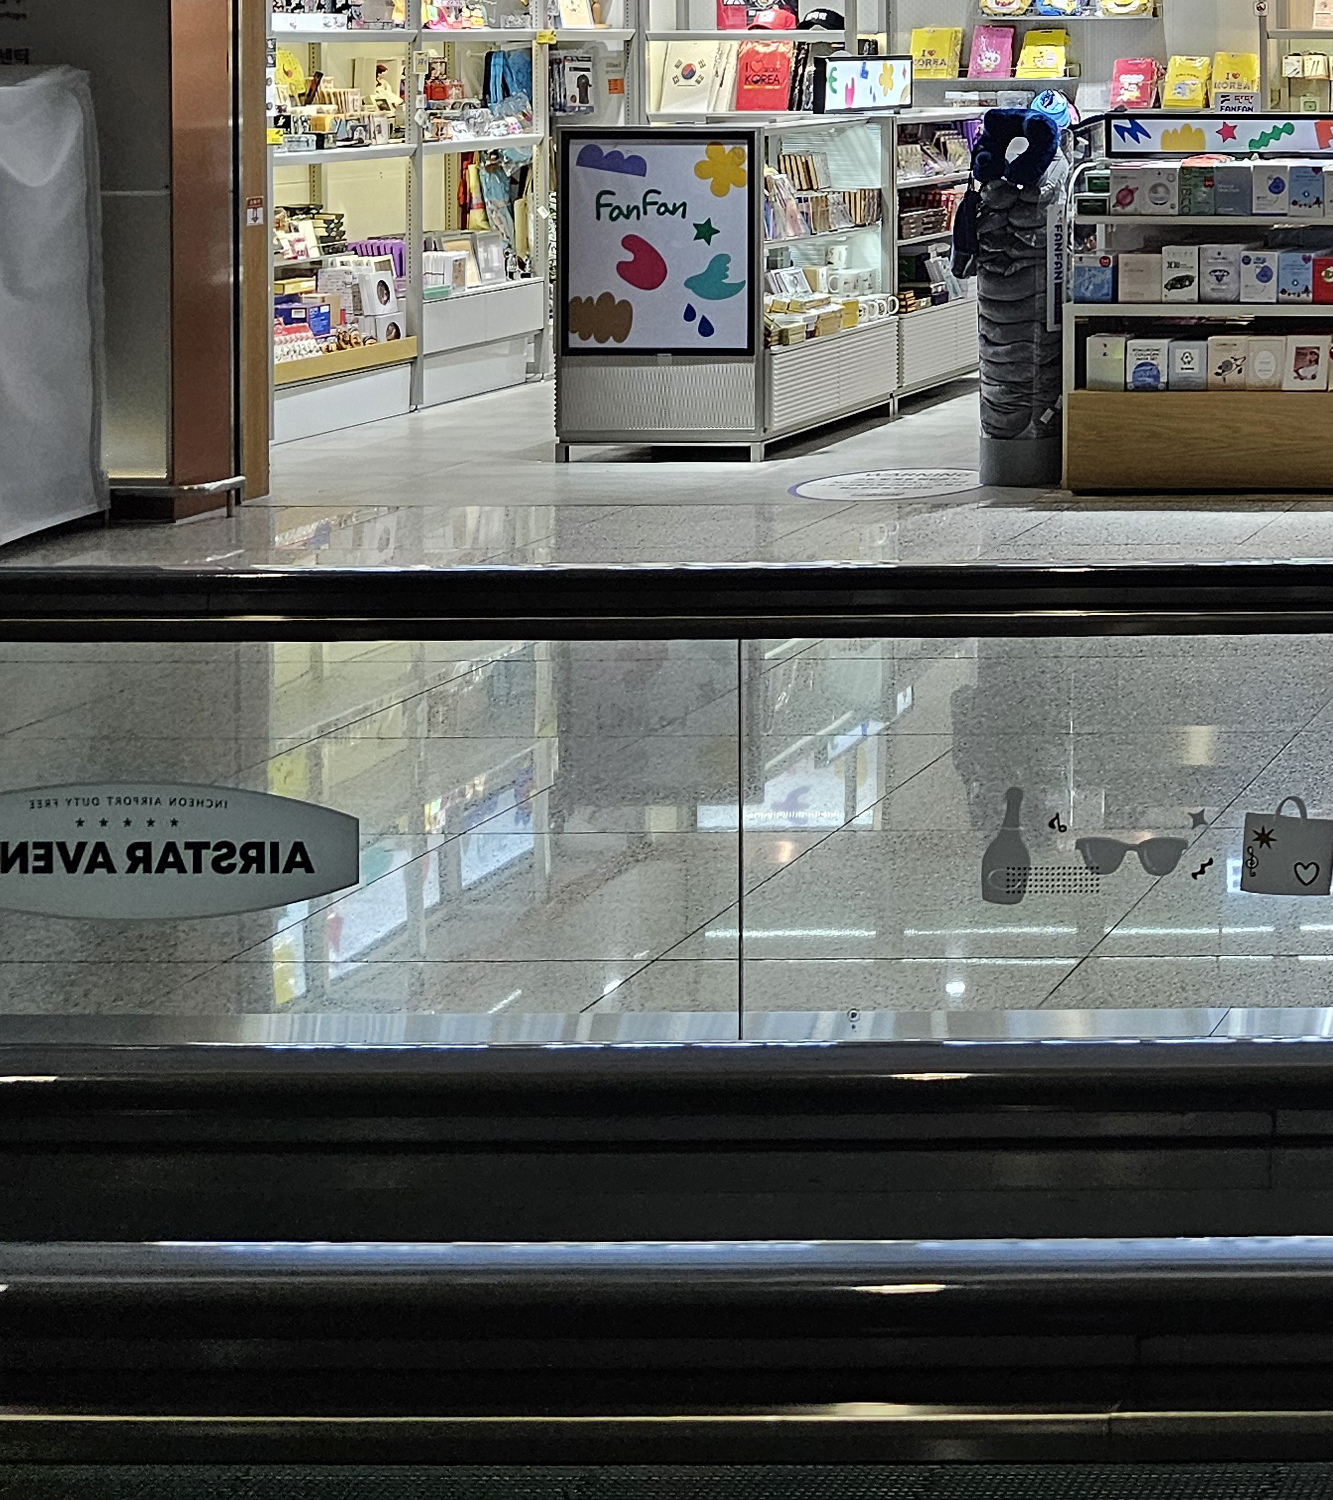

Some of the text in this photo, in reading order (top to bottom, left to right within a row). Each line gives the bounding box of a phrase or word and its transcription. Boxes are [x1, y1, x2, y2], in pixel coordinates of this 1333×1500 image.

[744, 74, 781, 86] KOREA
[595, 189, 688, 222] FanFan
[1054, 224, 1063, 281] FANFAN
